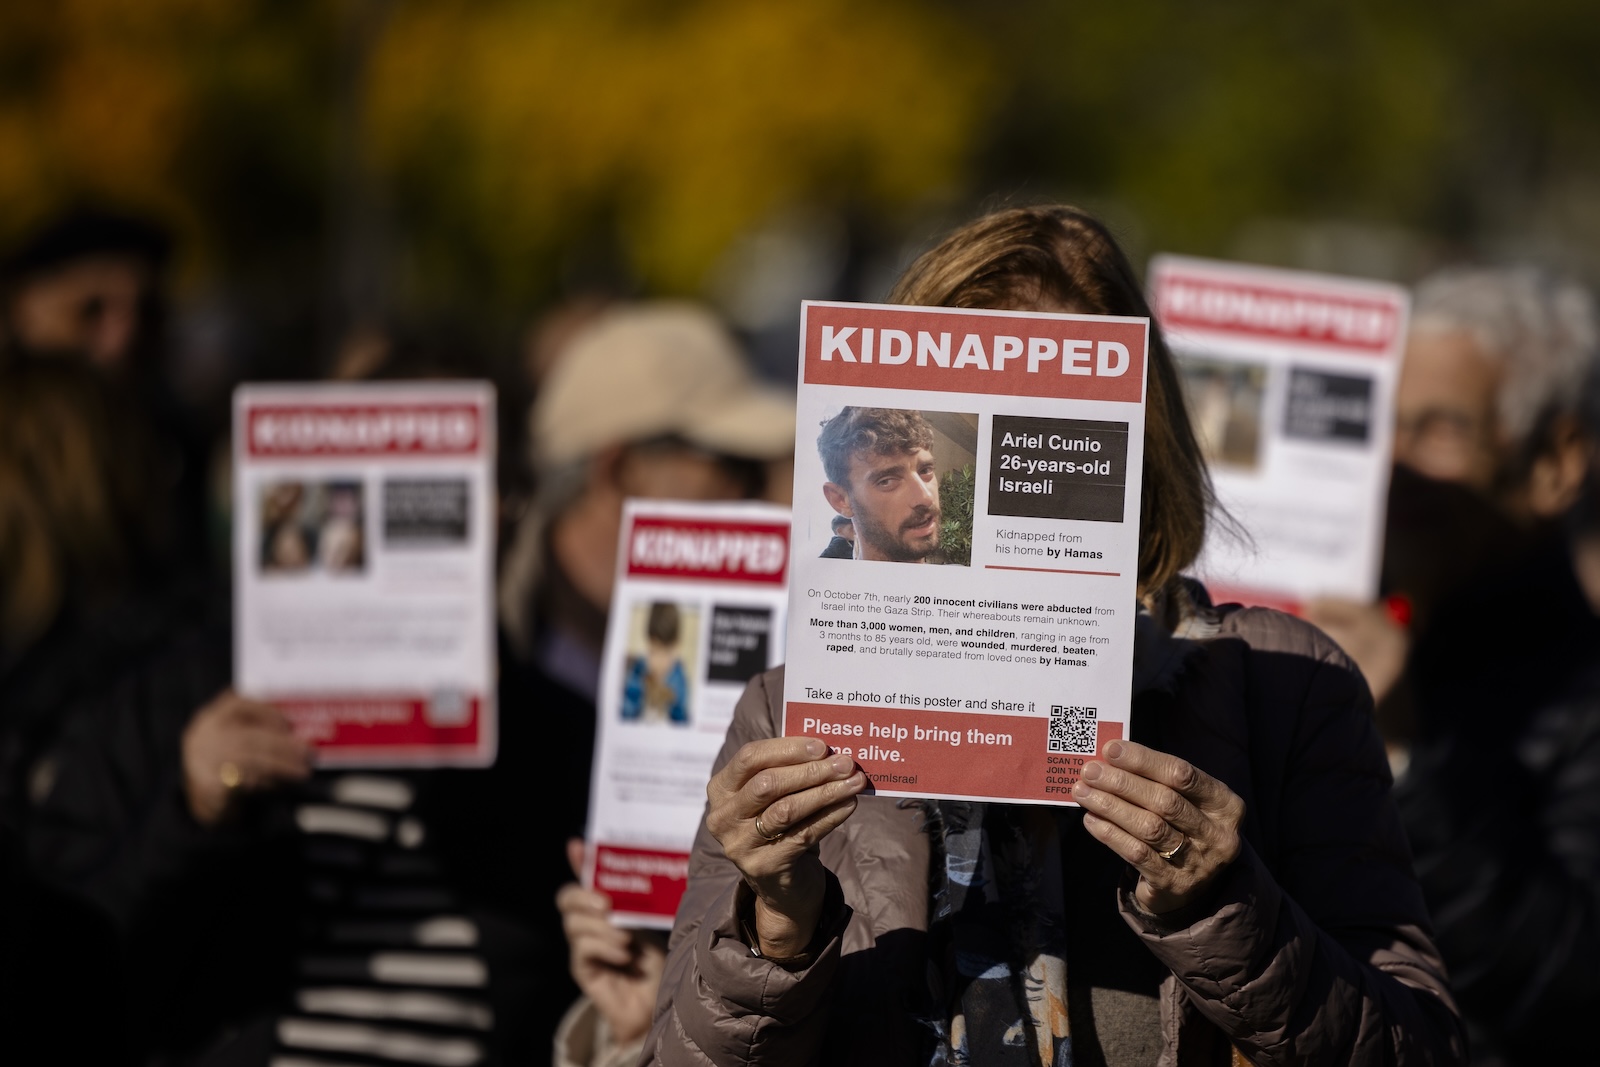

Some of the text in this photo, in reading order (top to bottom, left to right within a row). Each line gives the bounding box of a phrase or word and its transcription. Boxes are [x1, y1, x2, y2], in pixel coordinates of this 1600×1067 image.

[820, 325, 1131, 378] KIDNAPPED
[1001, 432, 1102, 452] Ariel Cunio
[999, 454, 1111, 476] 26-years-old
[999, 476, 1053, 495] Israeli
[996, 529, 1083, 543] Kidnapped from
[631, 527, 786, 574] KIDNAPPED
[995, 544, 1103, 560] his home by Hamas
[808, 588, 1115, 616] On October 7th, nearly 200 innocent civilians were abducted from
[821, 602, 1100, 627] Israel into the Gaza Strip. Their whereabouts remain unknown.
[810, 618, 1110, 645] More than 3,000 women, men, and children, ranging in age from
[819, 631, 1098, 656] 3 months to 85 years old, were wounded, murdered, beaten,
[826, 643, 1089, 667] raped, and brutally separated from loved ones by Hamas.
[805, 687, 1036, 712] Take a photo of this poster and share it
[803, 717, 1013, 747] Please help bring them
[857, 745, 905, 762] alive.
[1047, 756, 1084, 766] SCAN TO
[1045, 776, 1078, 785] GLOBA
[1046, 766, 1082, 776] JOIN TH
